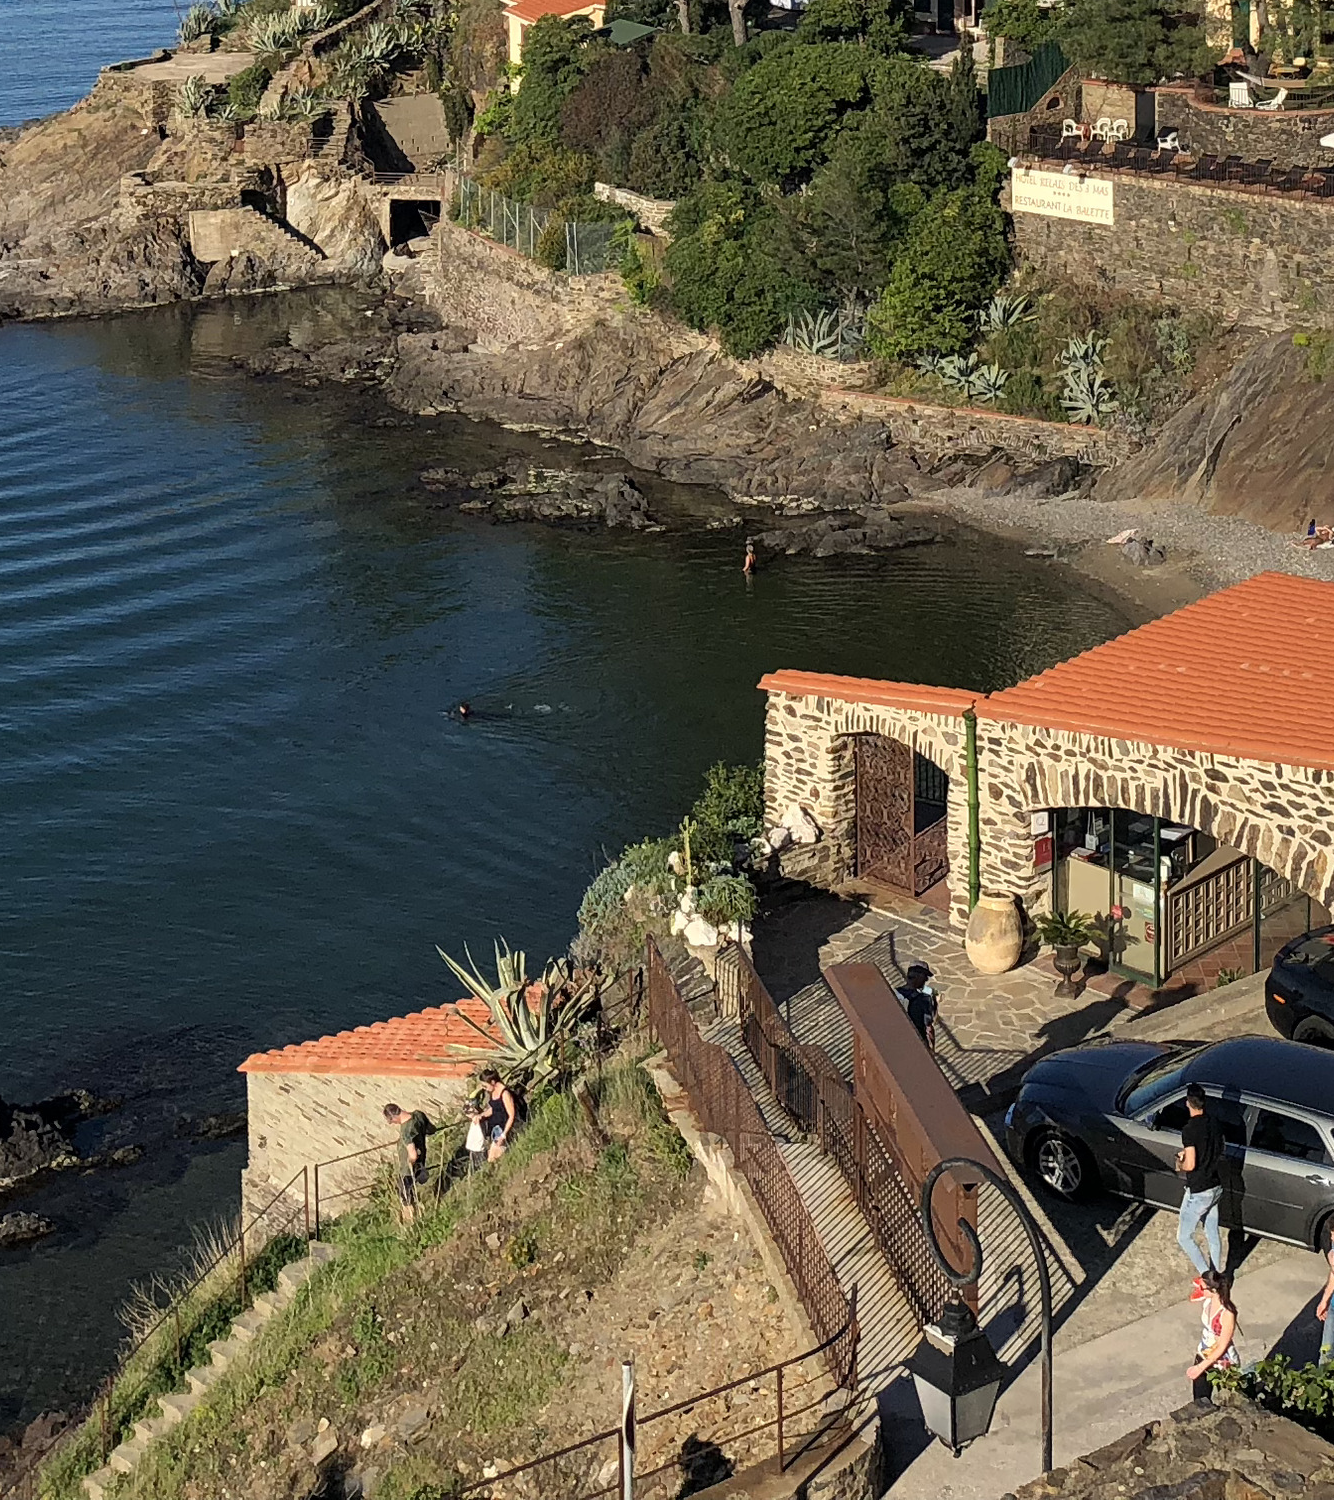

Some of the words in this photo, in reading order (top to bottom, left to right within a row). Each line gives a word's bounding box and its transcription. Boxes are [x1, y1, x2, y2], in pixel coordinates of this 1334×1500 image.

[1040, 177, 1065, 190] RELAIS
[1069, 181, 1083, 193] DES
[1085, 184, 1090, 194] 3
[1093, 184, 1109, 197] MAS
[1015, 195, 1061, 211] RESTAURANT
[1063, 204, 1073, 215] LA
[1076, 205, 1110, 220] BALETTE
